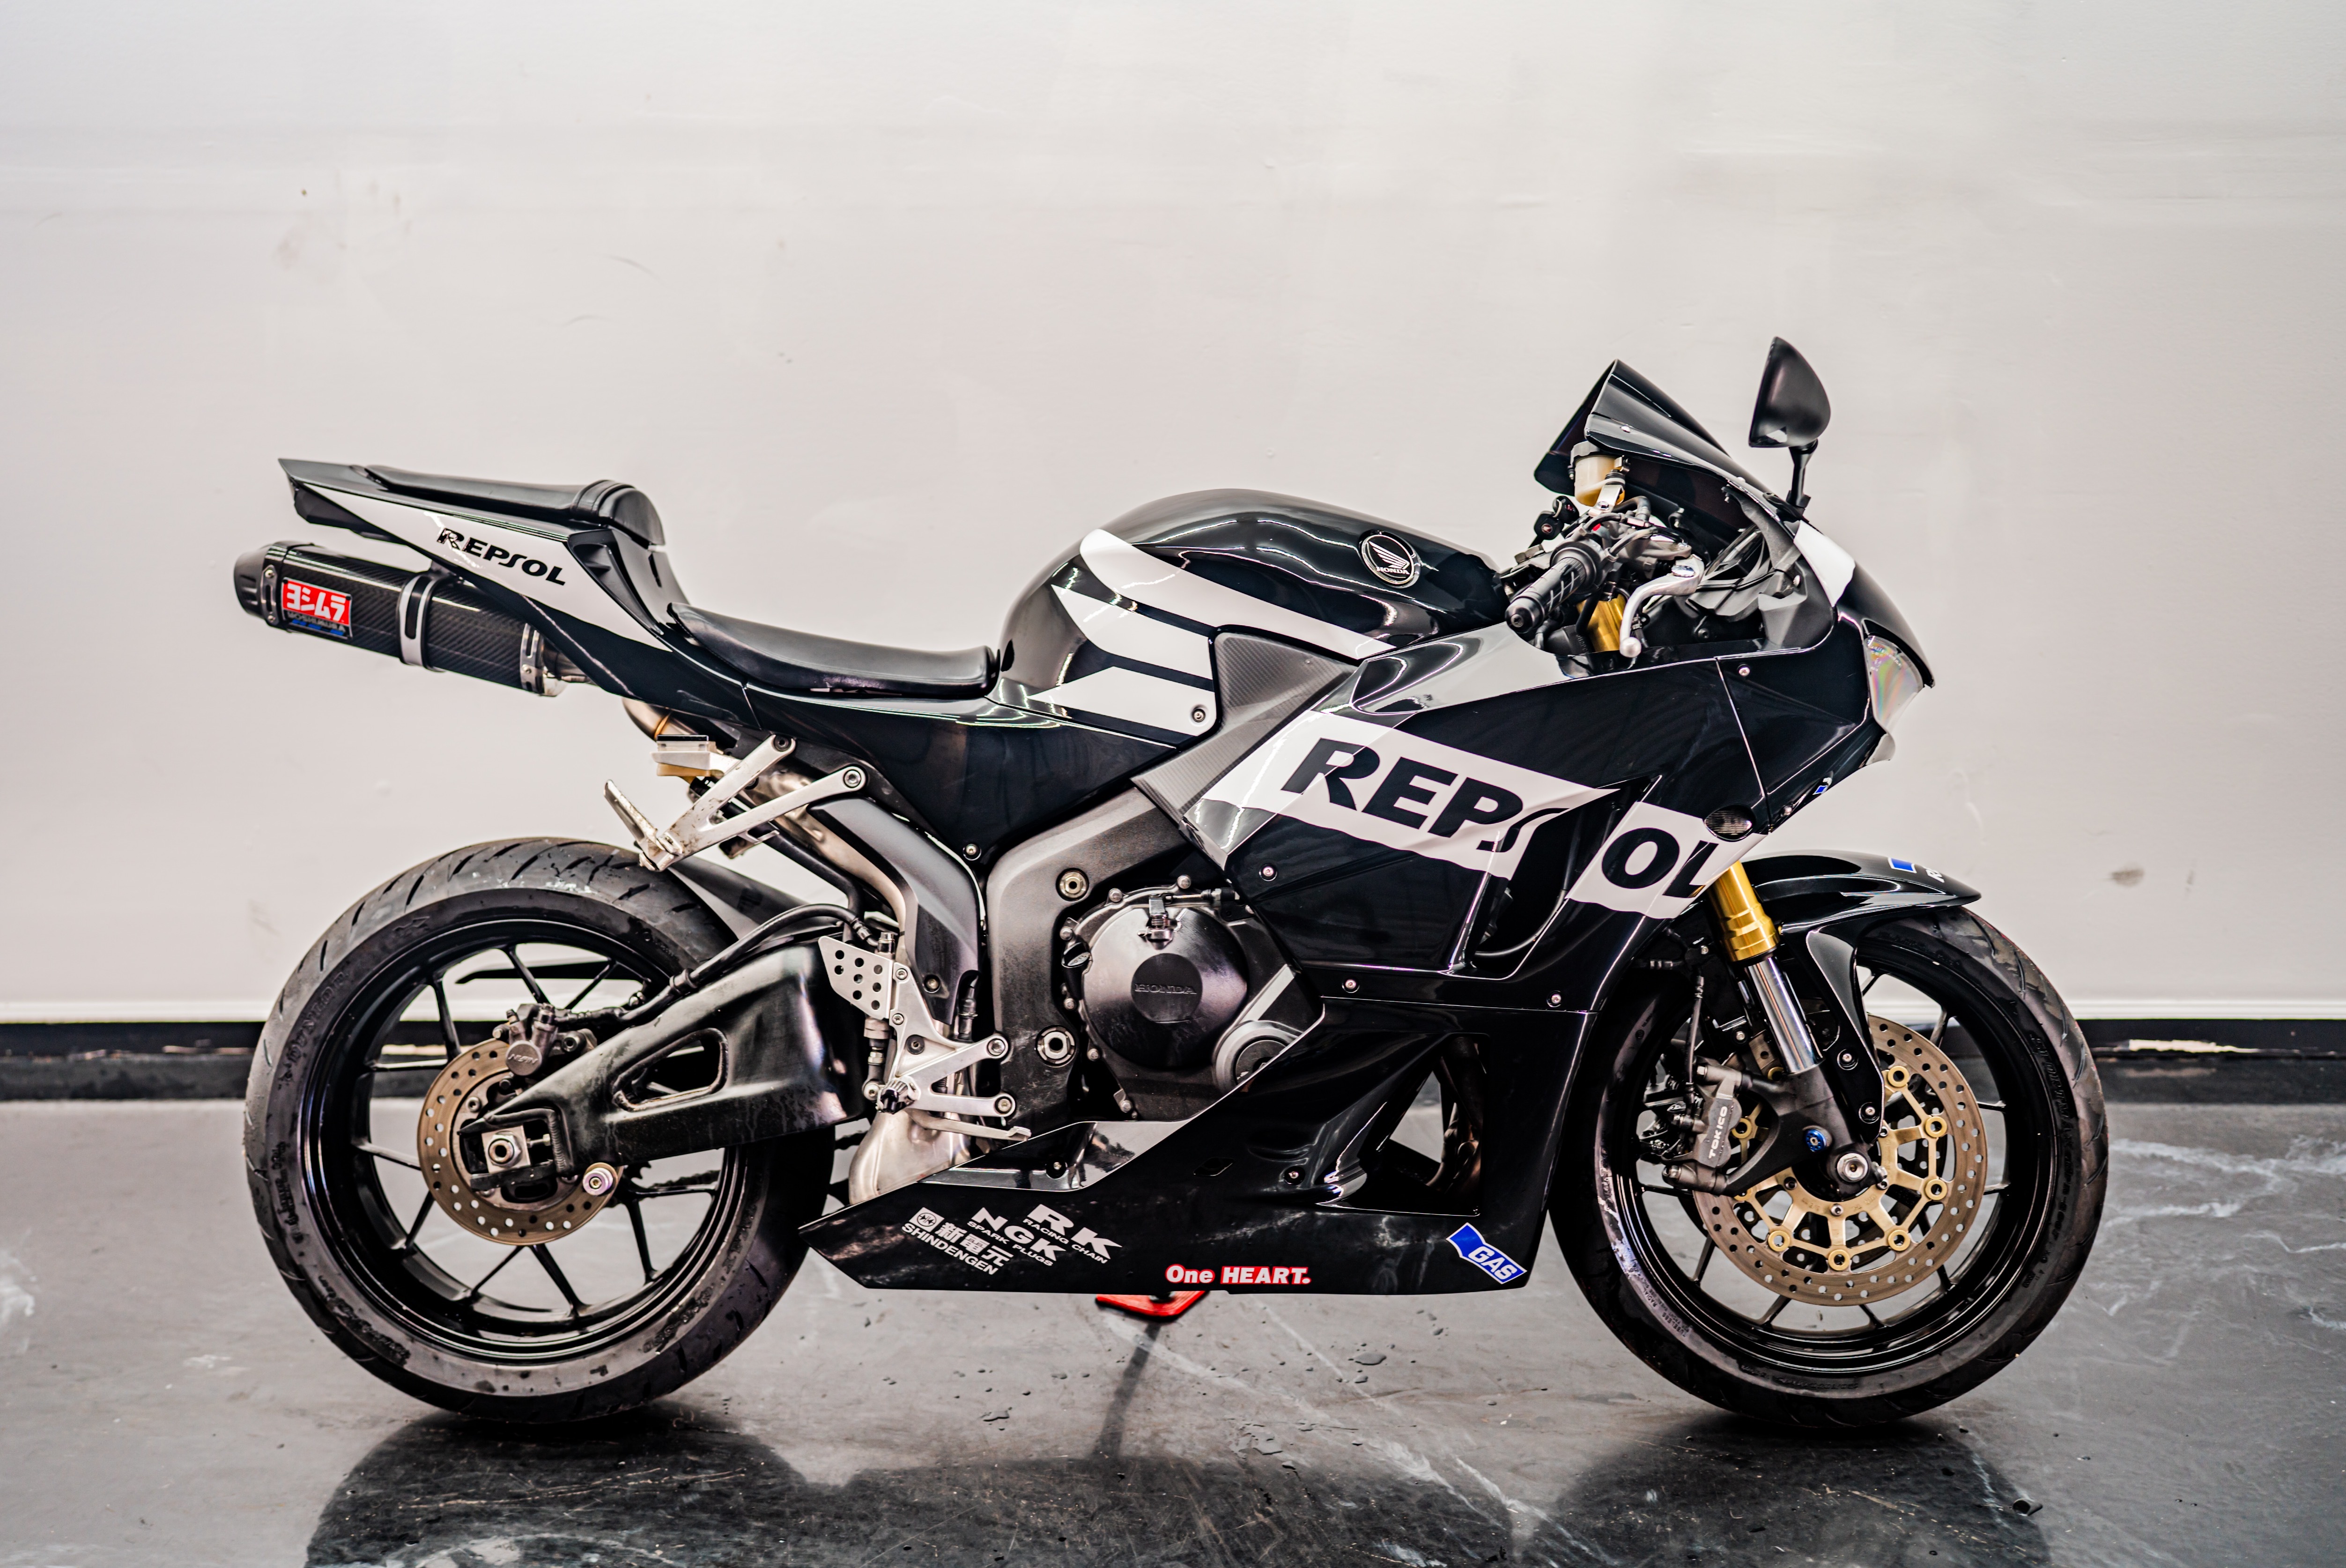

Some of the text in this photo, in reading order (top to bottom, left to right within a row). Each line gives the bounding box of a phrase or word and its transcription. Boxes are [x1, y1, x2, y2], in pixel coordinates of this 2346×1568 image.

[437, 528, 565, 586] REPSOL
[287, 583, 346, 621] ヨシムラ
[1281, 737, 1720, 899] REPSOL
[1134, 984, 1197, 994] HONDA
[1709, 1106, 1728, 1159] TOKICO
[902, 1223, 999, 1275] SHINDENGEN
[935, 1222, 1014, 1267] 新電元
[967, 1221, 1054, 1266] SPARK PLUGS
[971, 1207, 1066, 1261] NGK
[1022, 1219, 1108, 1264] RACING CHAIN
[1027, 1204, 1123, 1259] RK
[1166, 1265, 1311, 1284] One HEART.
[1468, 1246, 1517, 1280] GAS
[1640, 1286, 1658, 1308] RADIAL
